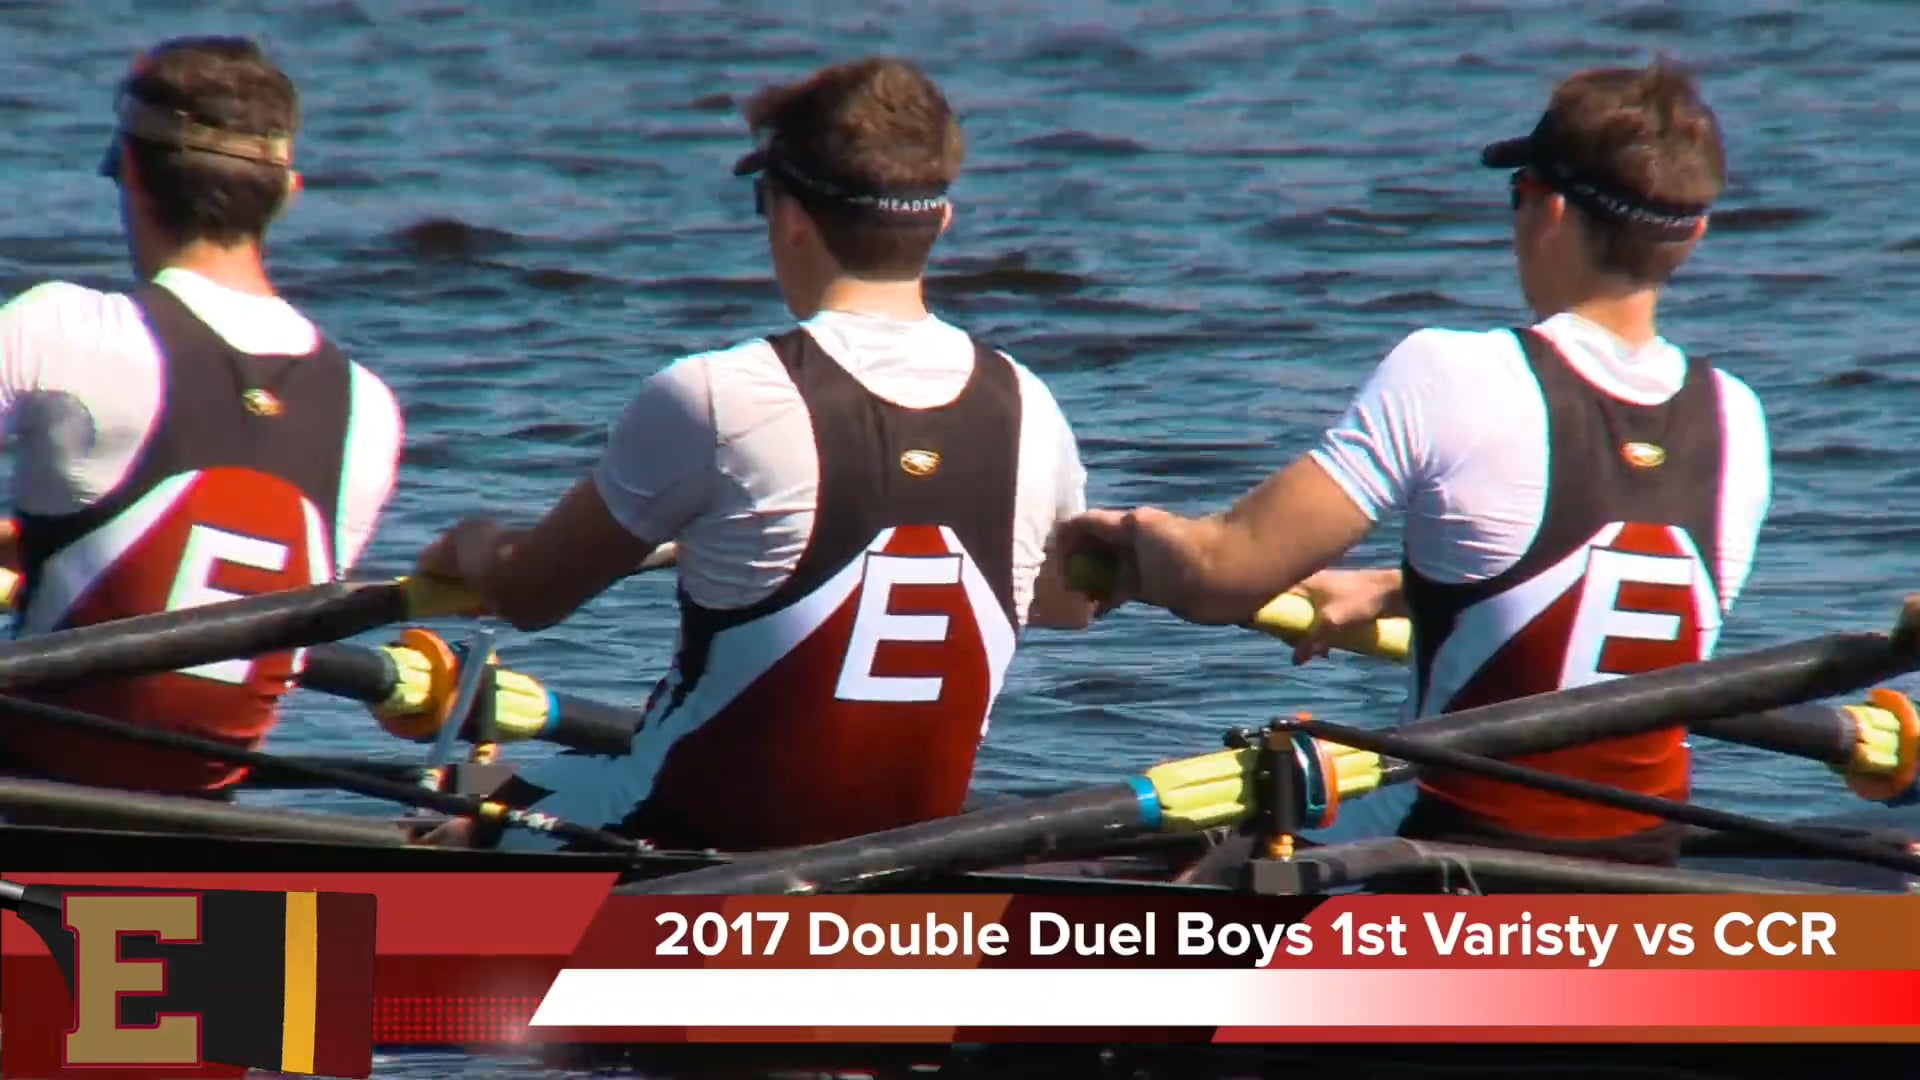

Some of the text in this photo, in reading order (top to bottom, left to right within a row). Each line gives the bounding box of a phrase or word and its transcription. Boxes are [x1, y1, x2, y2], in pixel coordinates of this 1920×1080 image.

[165, 523, 289, 685] E
[834, 551, 963, 702] E
[1559, 546, 1694, 691] E
